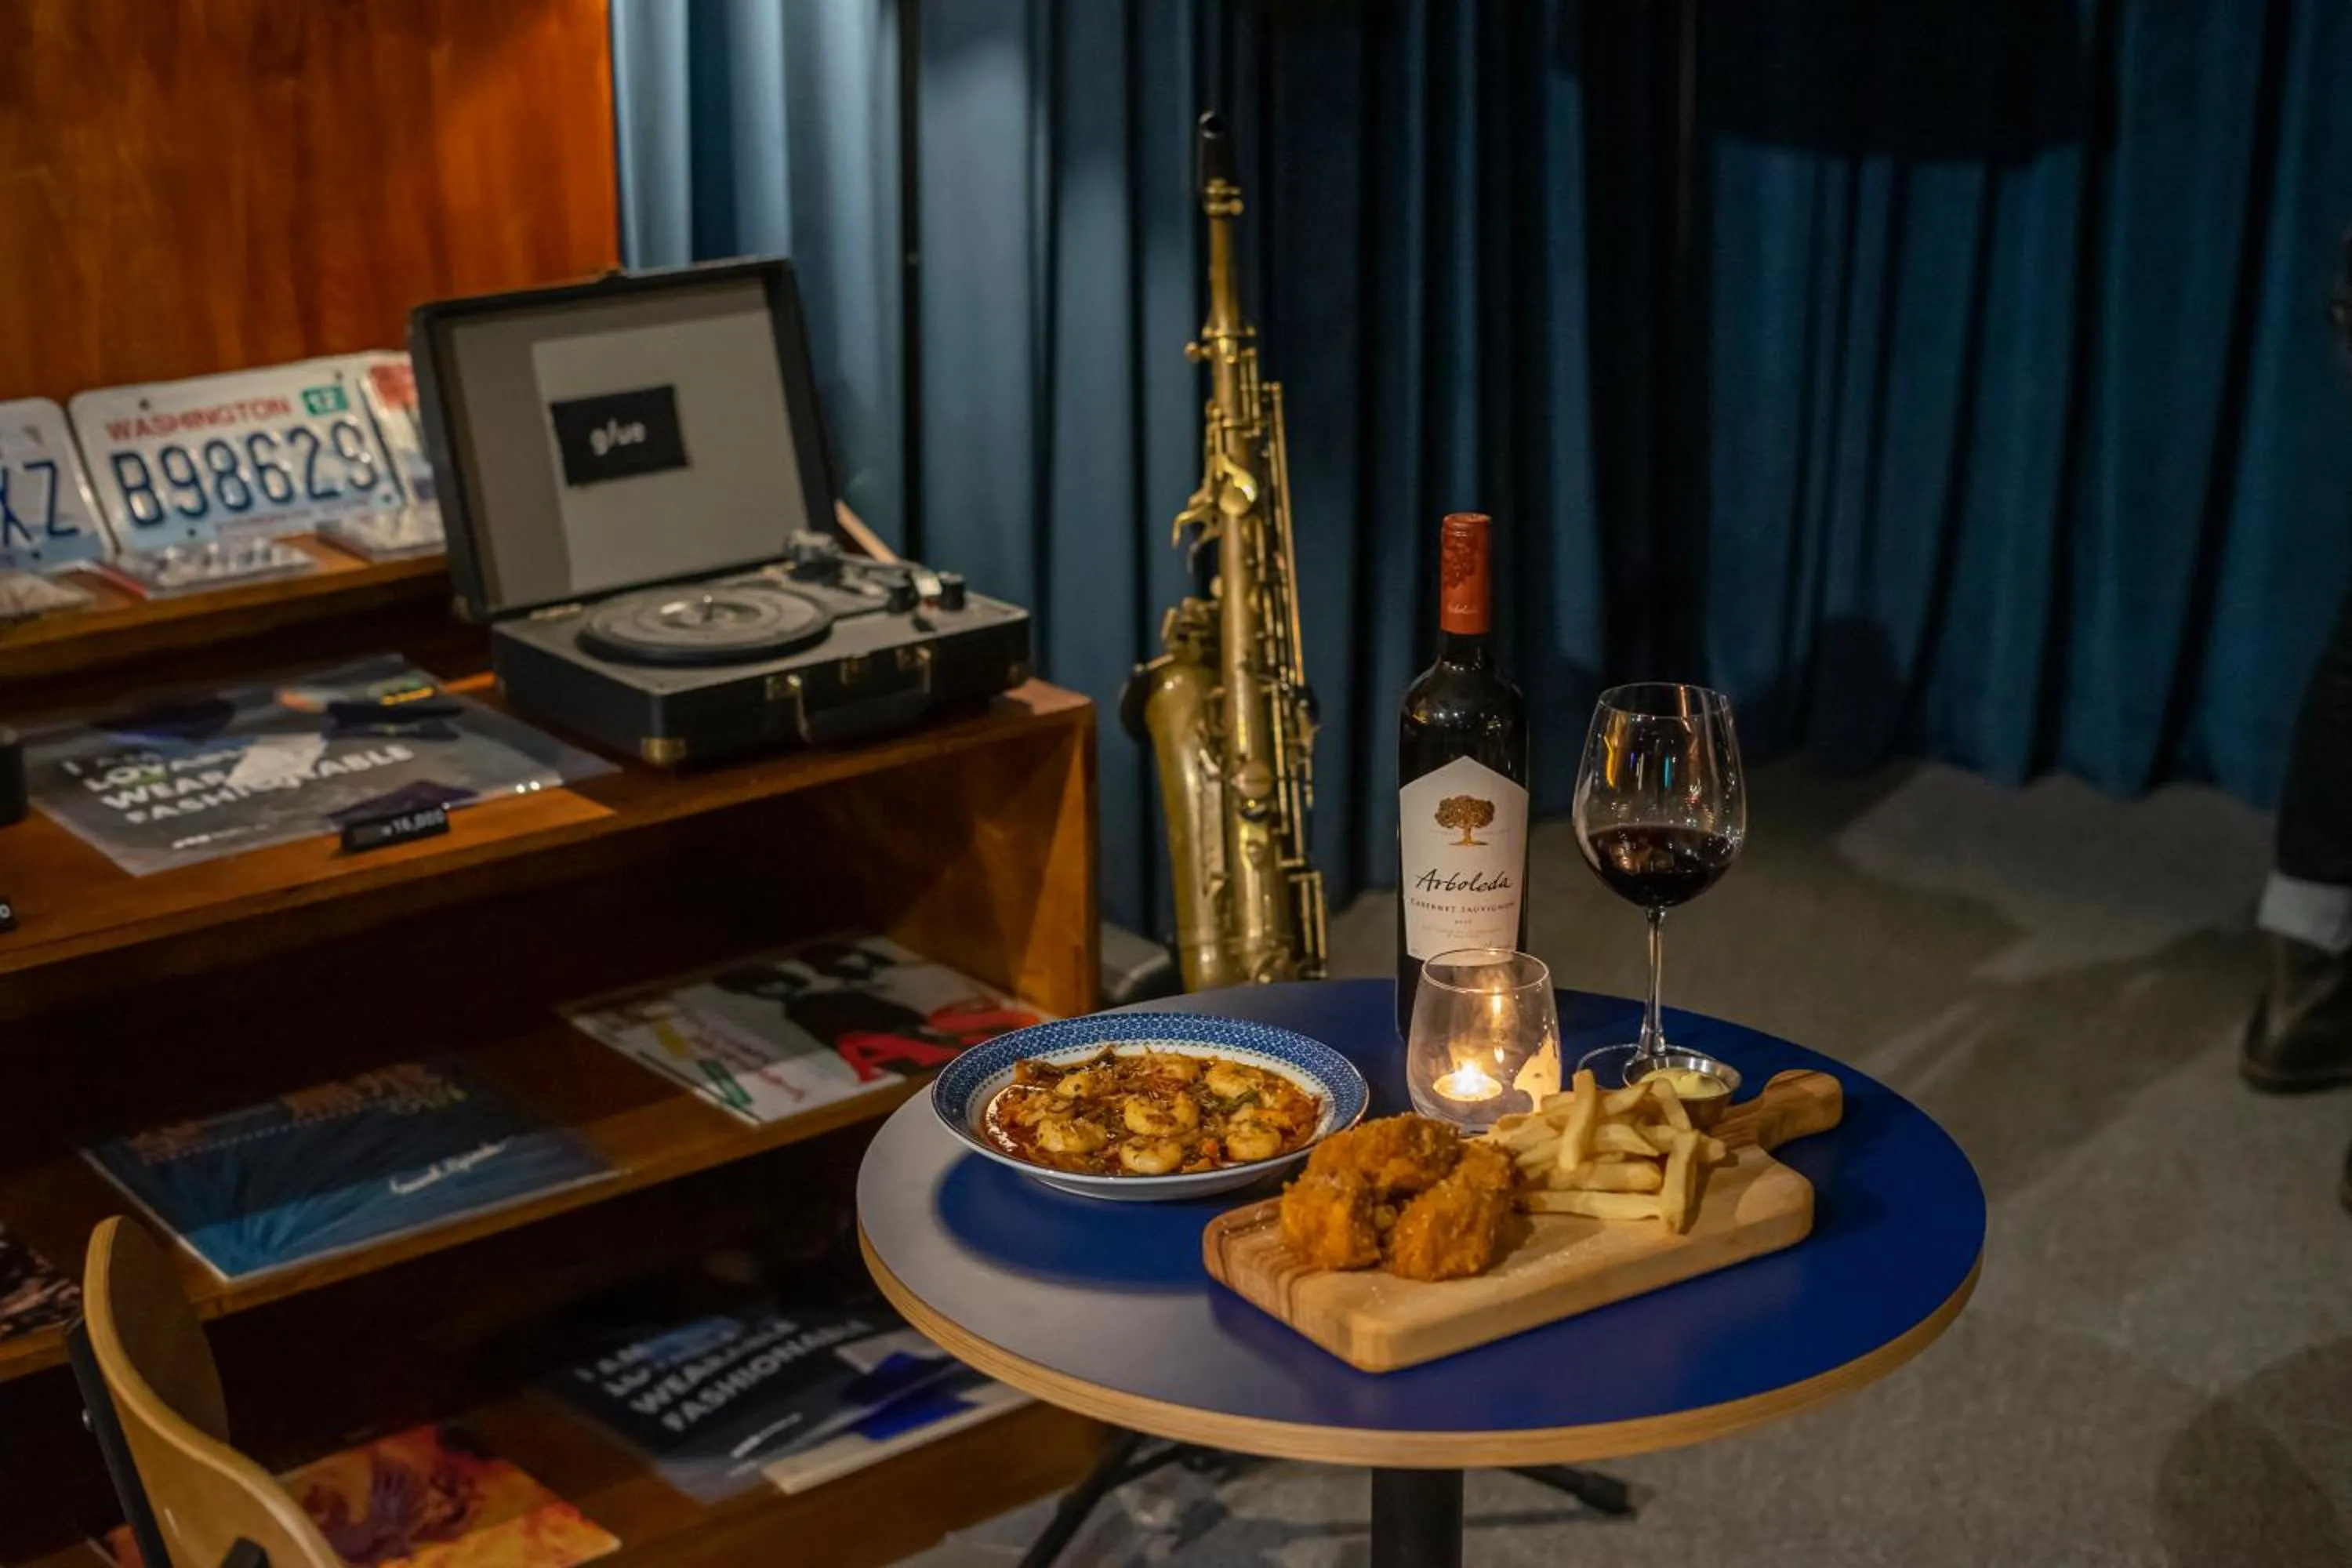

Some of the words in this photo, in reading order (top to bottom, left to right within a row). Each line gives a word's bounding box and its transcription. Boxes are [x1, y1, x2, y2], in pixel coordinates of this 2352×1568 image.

[106, 397, 292, 441] WASHINGTON
[110, 419, 379, 528] B98629
[1414, 867, 1512, 892] Arboleda
[1410, 896, 1456, 913] CABERNET
